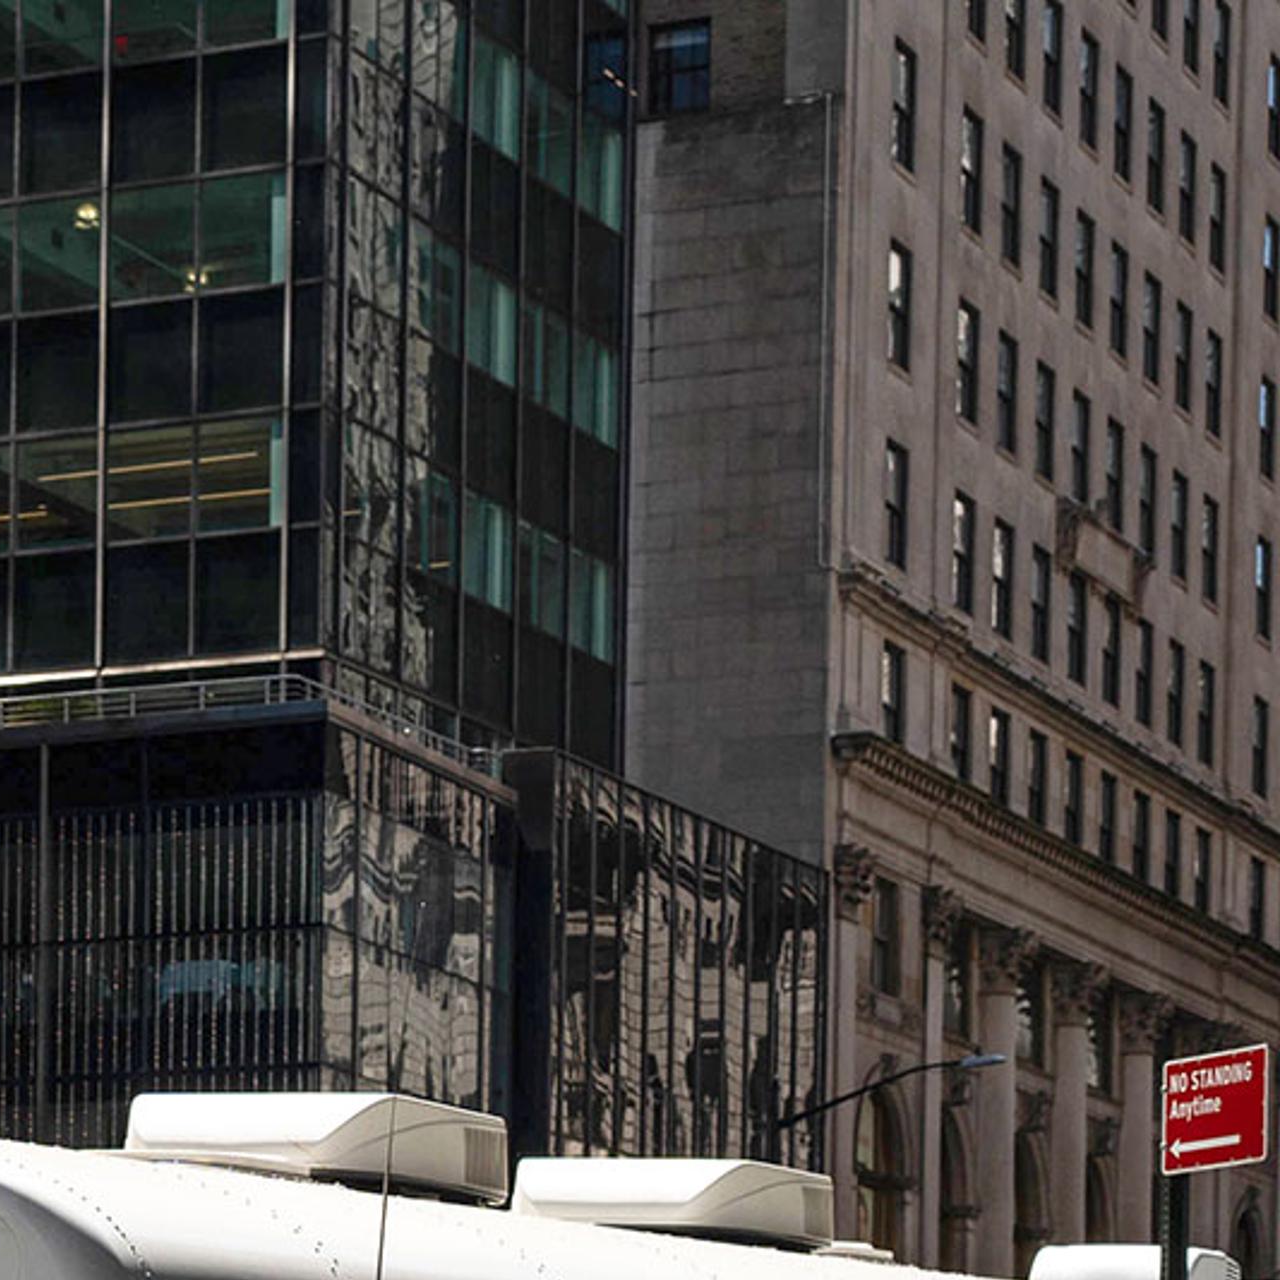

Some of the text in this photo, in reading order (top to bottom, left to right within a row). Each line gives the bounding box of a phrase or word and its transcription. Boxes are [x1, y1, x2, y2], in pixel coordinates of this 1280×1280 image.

[1168, 1061, 1252, 1094] NO STANDING
[1169, 1095, 1222, 1122] Anytime
